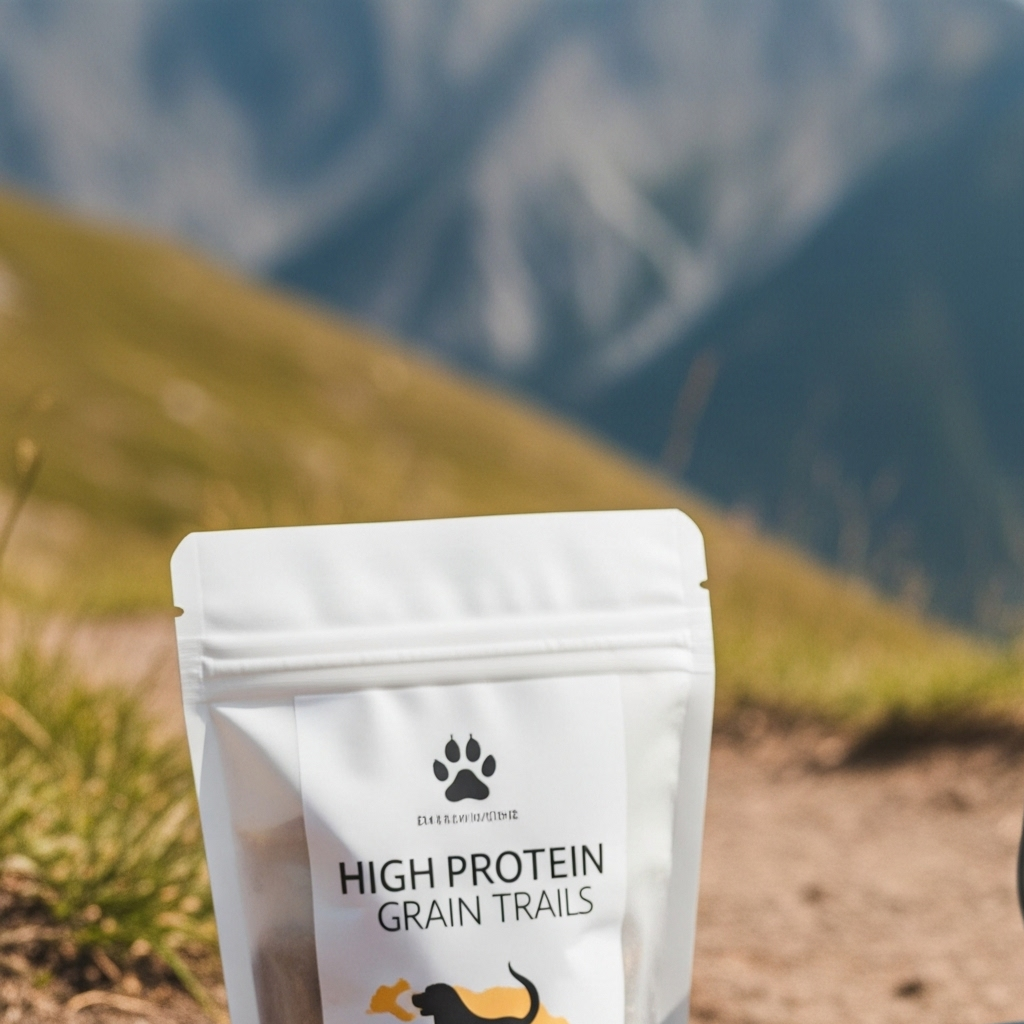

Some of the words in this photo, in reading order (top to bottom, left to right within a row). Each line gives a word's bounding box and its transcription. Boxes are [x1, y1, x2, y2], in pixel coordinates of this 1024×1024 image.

[339, 856, 435, 895] HIGH
[447, 842, 605, 888] PROTEIN
[377, 895, 483, 933] GRAIN
[492, 886, 595, 924] TRAILS
